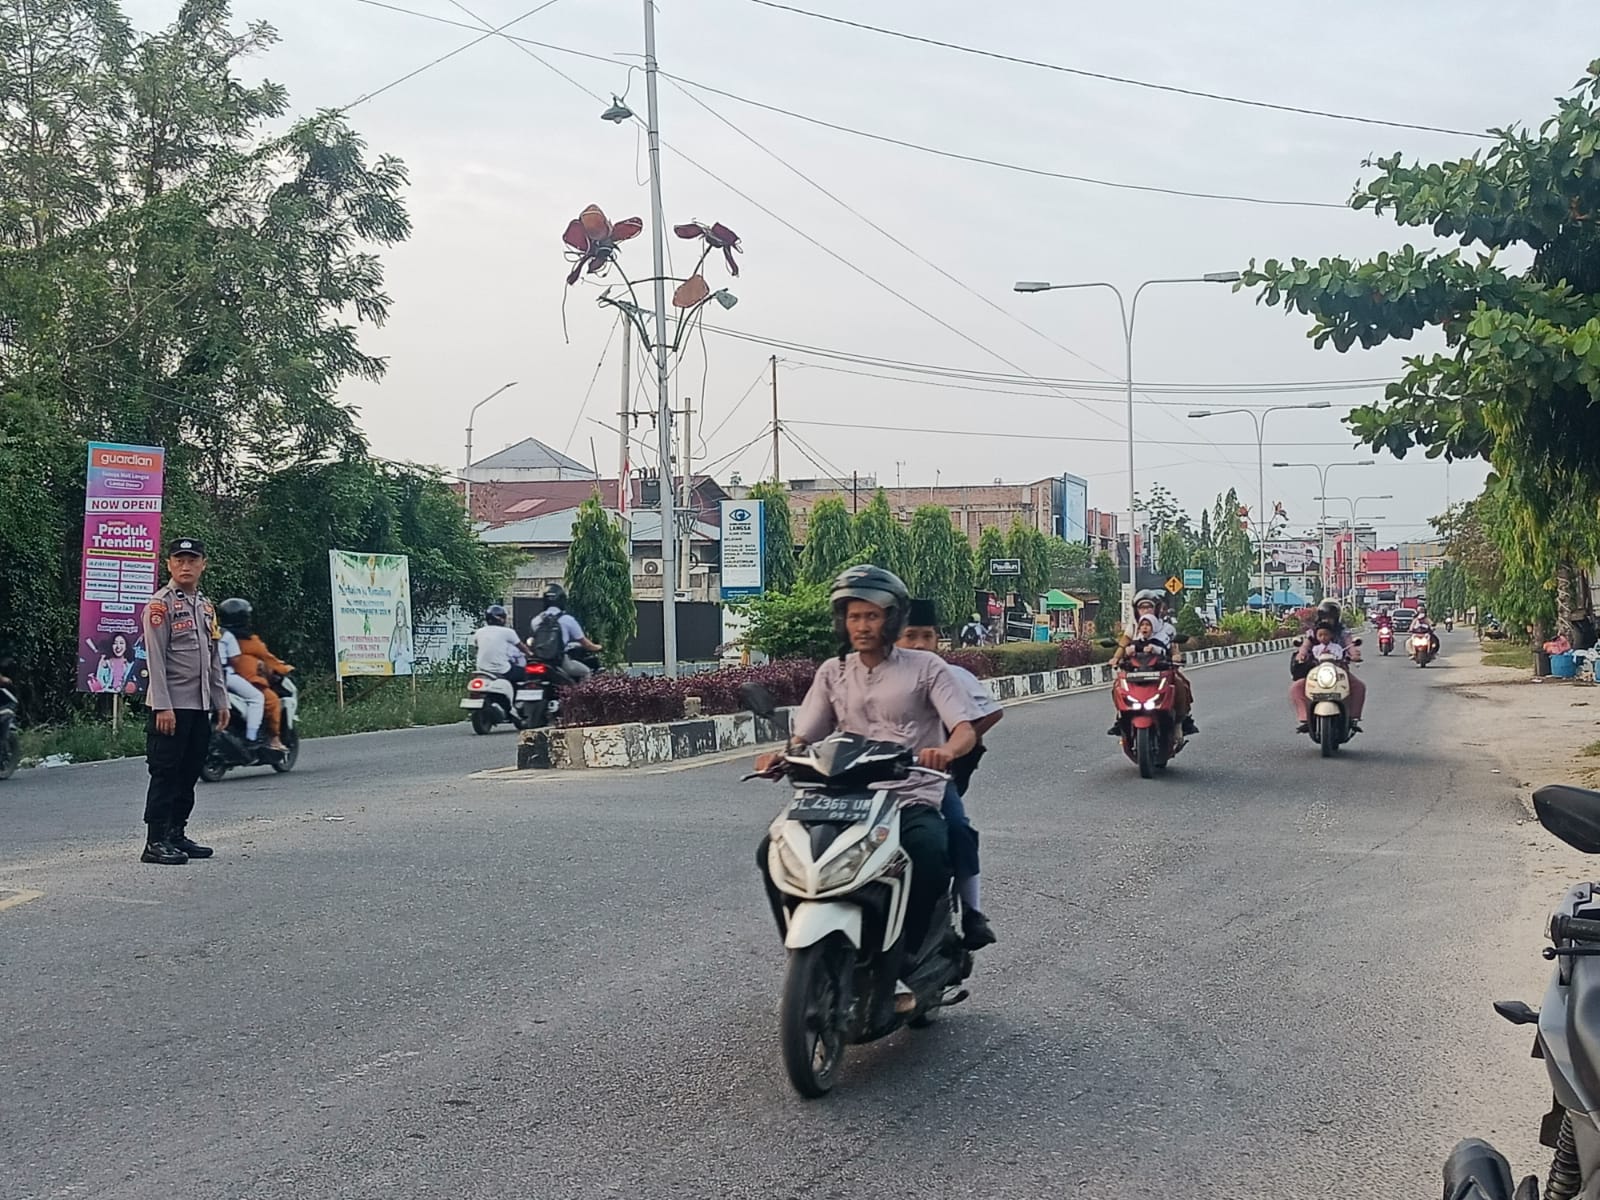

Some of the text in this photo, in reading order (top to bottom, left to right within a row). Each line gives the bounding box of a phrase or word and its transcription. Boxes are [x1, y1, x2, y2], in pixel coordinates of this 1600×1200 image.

[100, 454, 153, 466] guardian
[91, 500, 157, 510] NOW OPEN!
[98, 523, 148, 537] Produk
[92, 535, 154, 551] Trending
